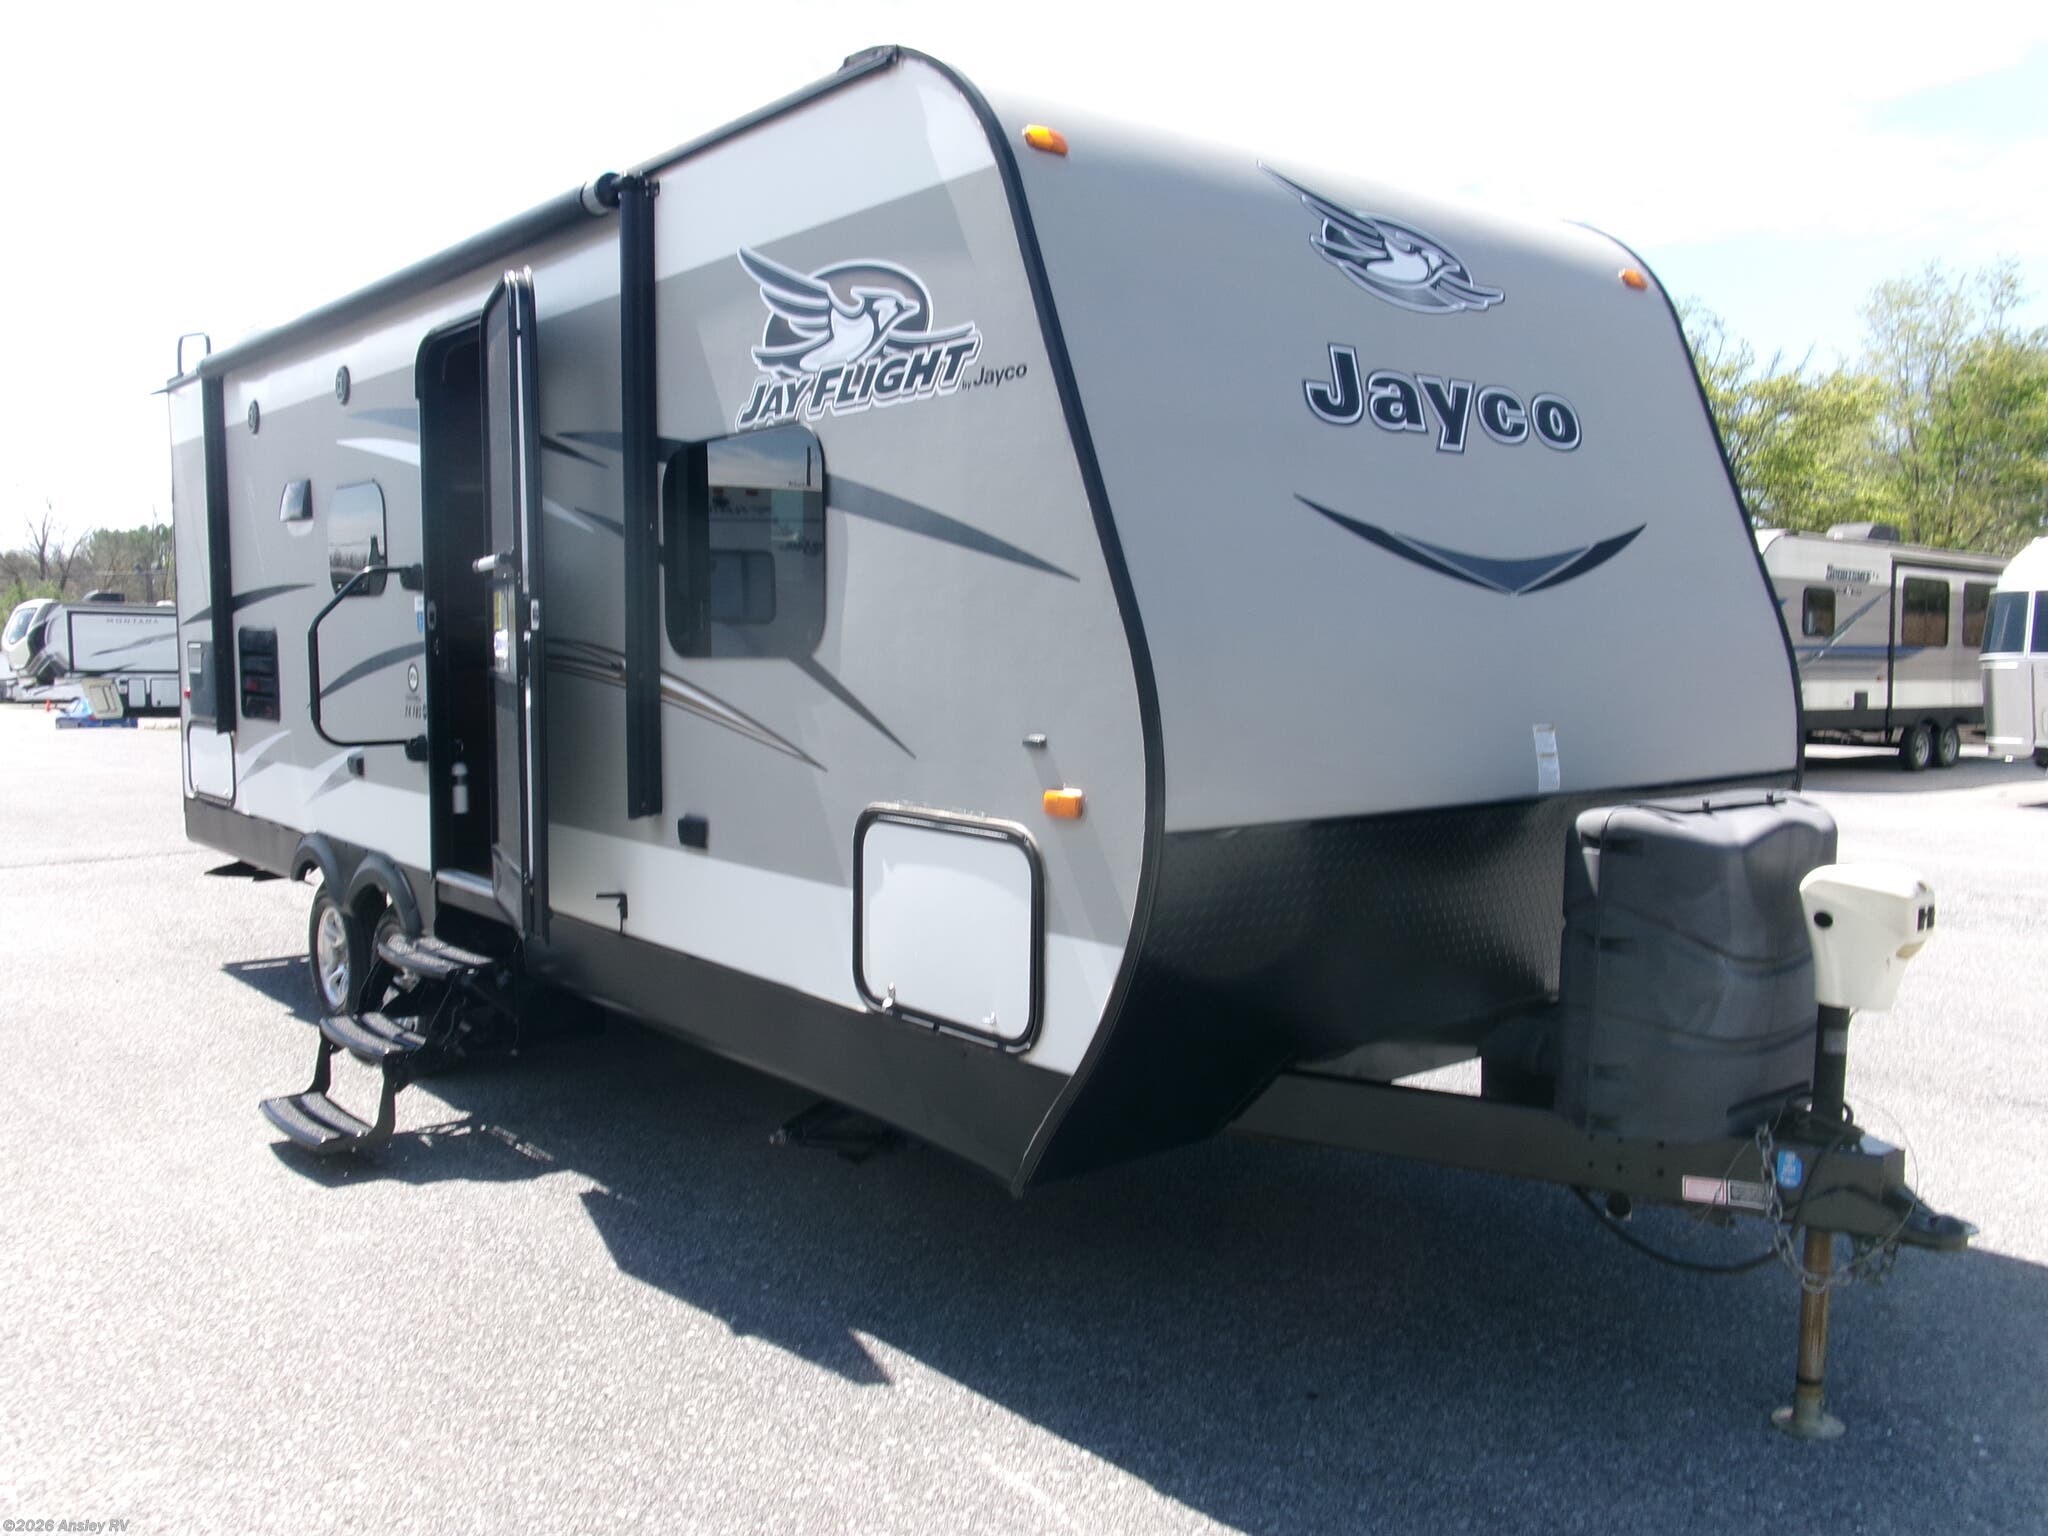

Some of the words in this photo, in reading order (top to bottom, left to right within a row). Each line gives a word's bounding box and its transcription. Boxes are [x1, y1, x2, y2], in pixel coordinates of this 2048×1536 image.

[961, 379, 972, 391] by
[973, 363, 1028, 388] Jayco
[1302, 342, 1583, 455] Jayco
